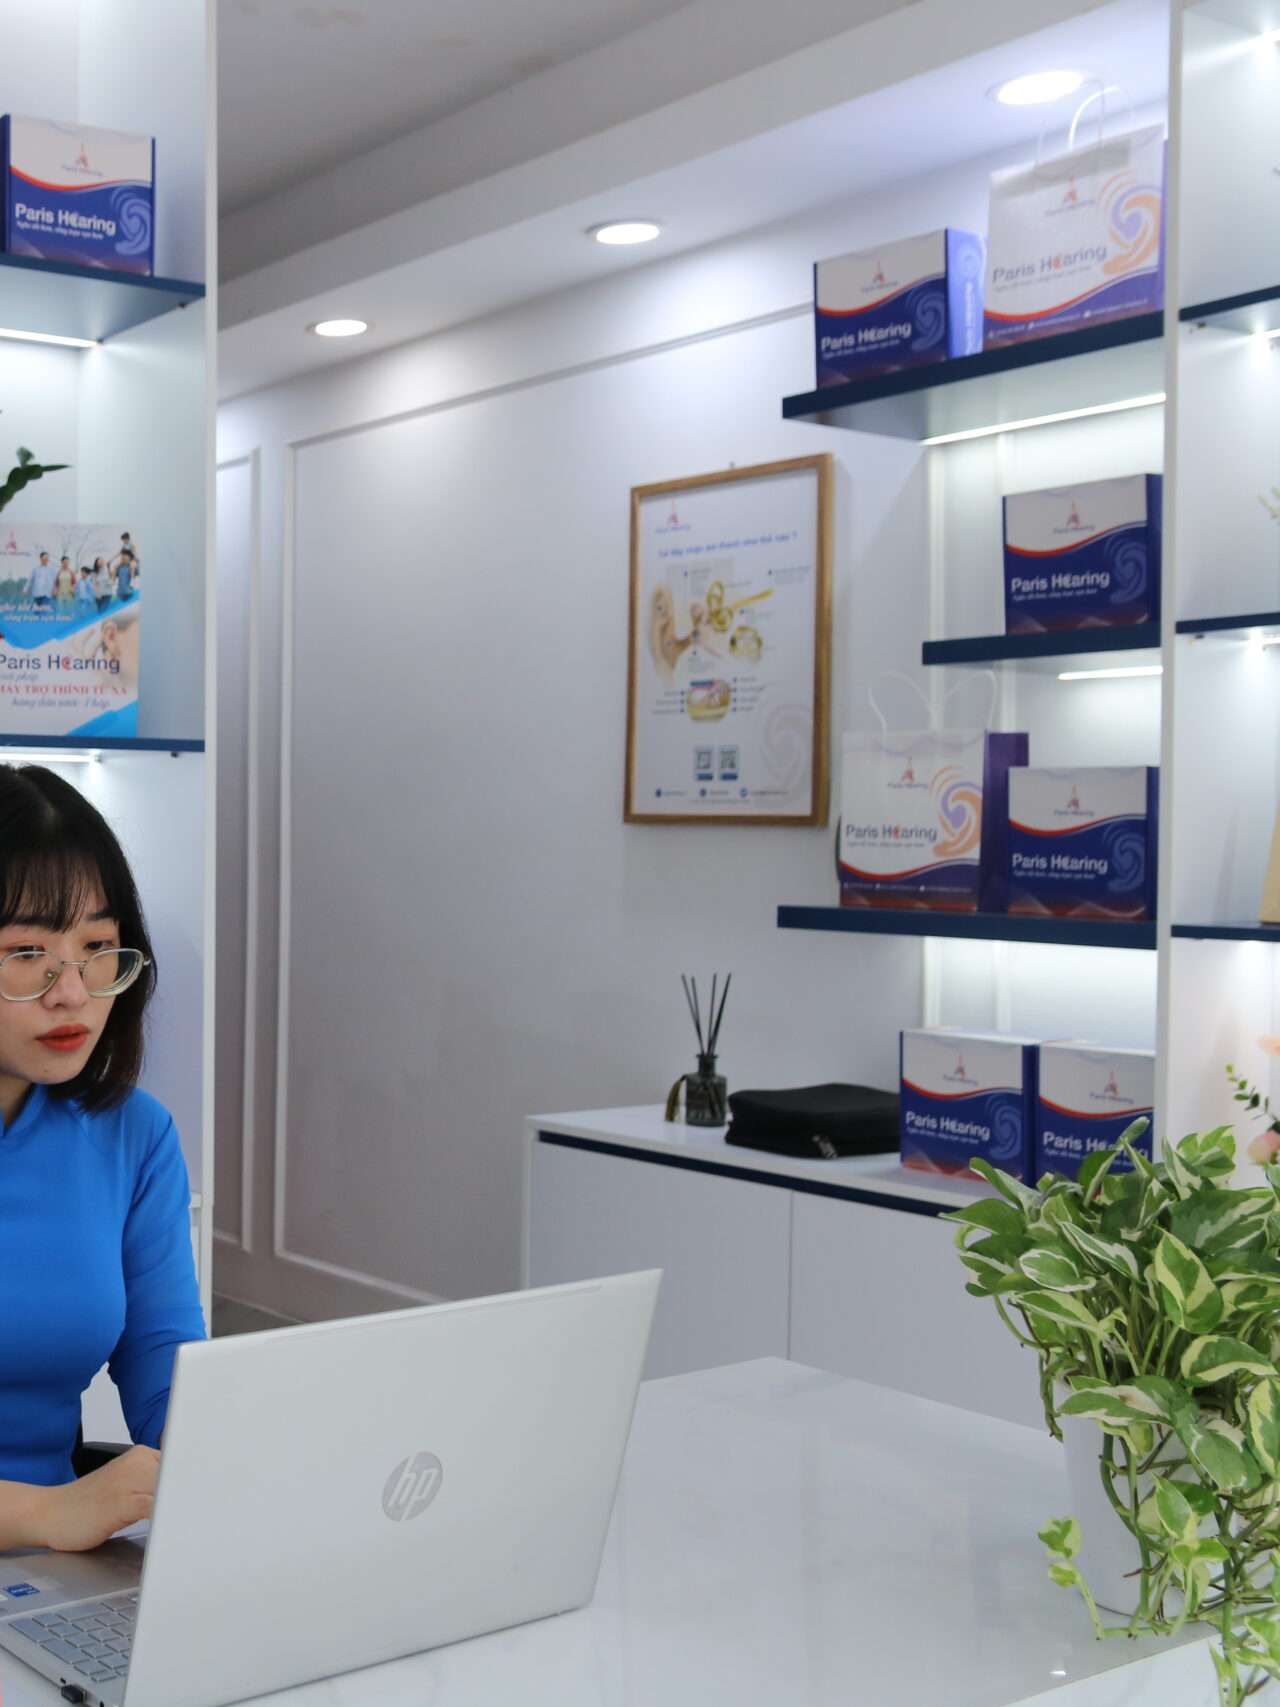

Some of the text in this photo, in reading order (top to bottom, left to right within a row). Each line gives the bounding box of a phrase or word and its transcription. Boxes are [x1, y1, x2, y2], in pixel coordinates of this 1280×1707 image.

[15, 202, 55, 224] Paris
[58, 209, 117, 237] Hearing
[992, 264, 1035, 283] Paris
[1040, 246, 1107, 273] Hearing
[821, 330, 855, 352] Paris
[1011, 571, 1110, 593] Paris Hearing
[48, 654, 121, 674] Hearing
[846, 824, 937, 842] Paris Hearing
[1012, 853, 1048, 869] Paris
[1050, 854, 1108, 875] Hearing
[906, 1111, 937, 1130] Paris
[940, 1116, 991, 1141] Hearing
[1043, 1131, 1083, 1151] Paris
